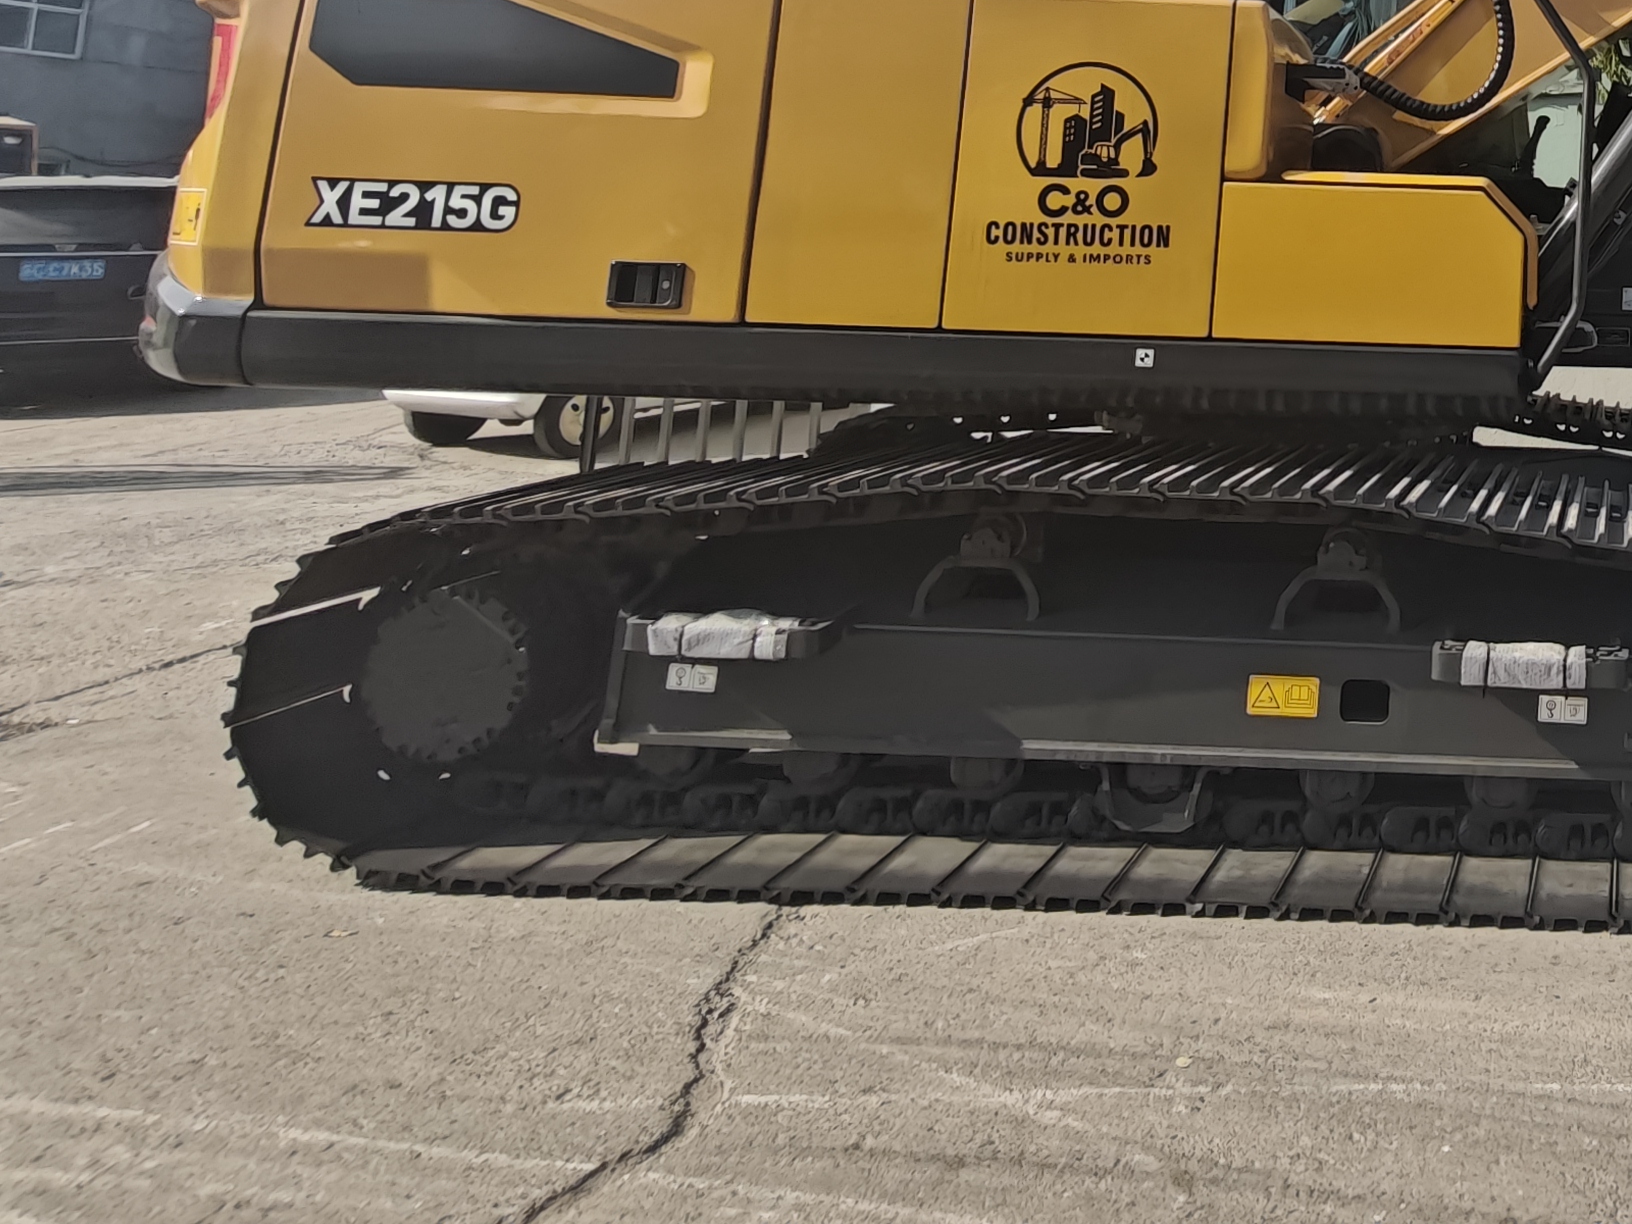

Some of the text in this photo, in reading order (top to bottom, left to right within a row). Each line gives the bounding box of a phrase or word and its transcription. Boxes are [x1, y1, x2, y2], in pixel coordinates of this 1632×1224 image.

[308, 179, 519, 230] XE215G
[1037, 182, 1131, 219] C&O
[985, 220, 1172, 249] CONSTRUCTION
[1005, 251, 1153, 265] SUPPLY & IMPORTS
